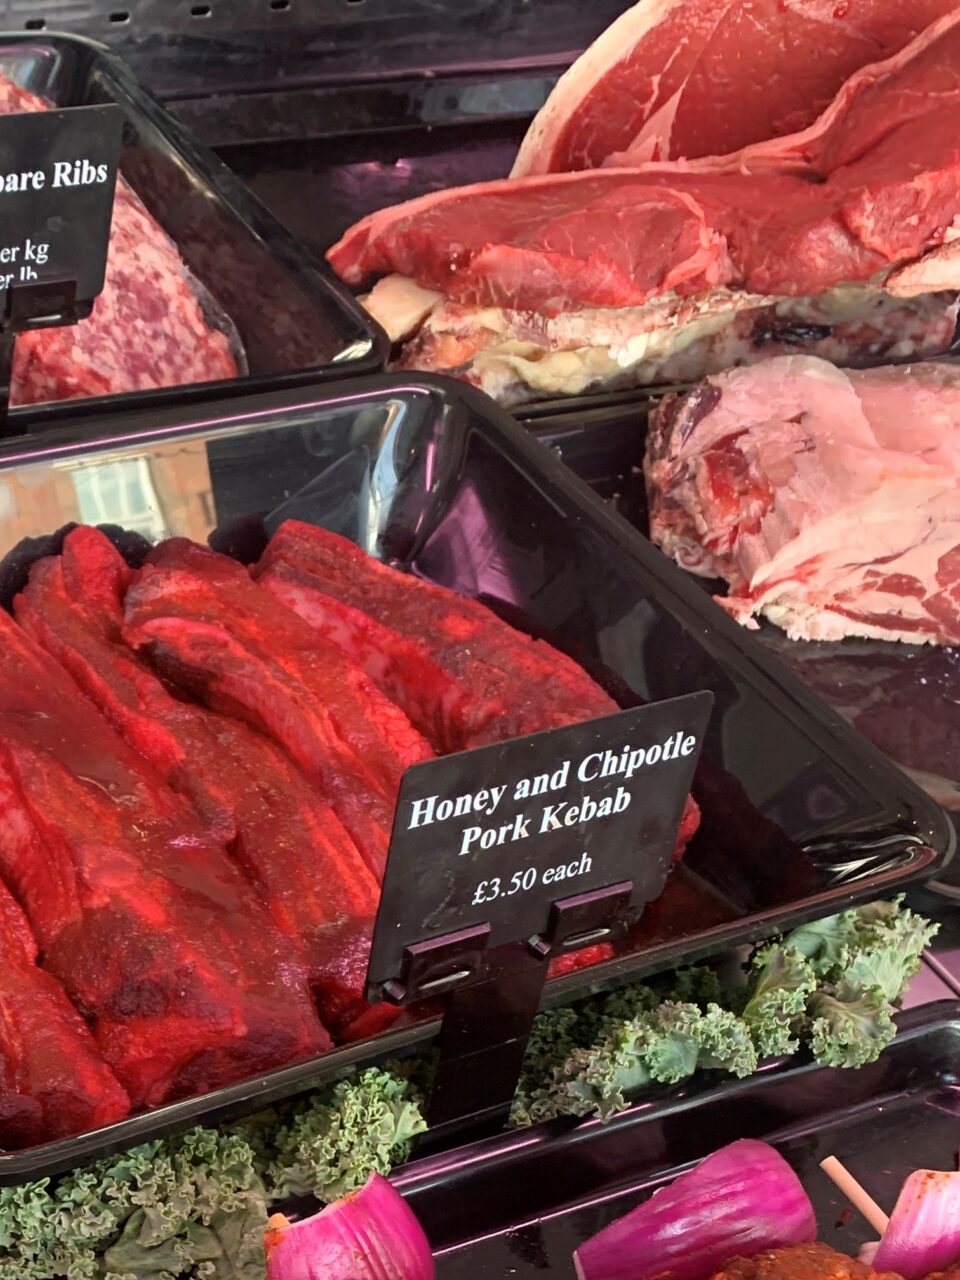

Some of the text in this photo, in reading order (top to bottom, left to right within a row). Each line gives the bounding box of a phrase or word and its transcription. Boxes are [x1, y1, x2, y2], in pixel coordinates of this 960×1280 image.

[51, 160, 108, 187] Ribs
[25, 239, 49, 263] kg
[407, 731, 696, 829] Honey and Chipotle
[459, 787, 631, 855] Pork Kebab
[472, 852, 592, 905] £3.50 each
